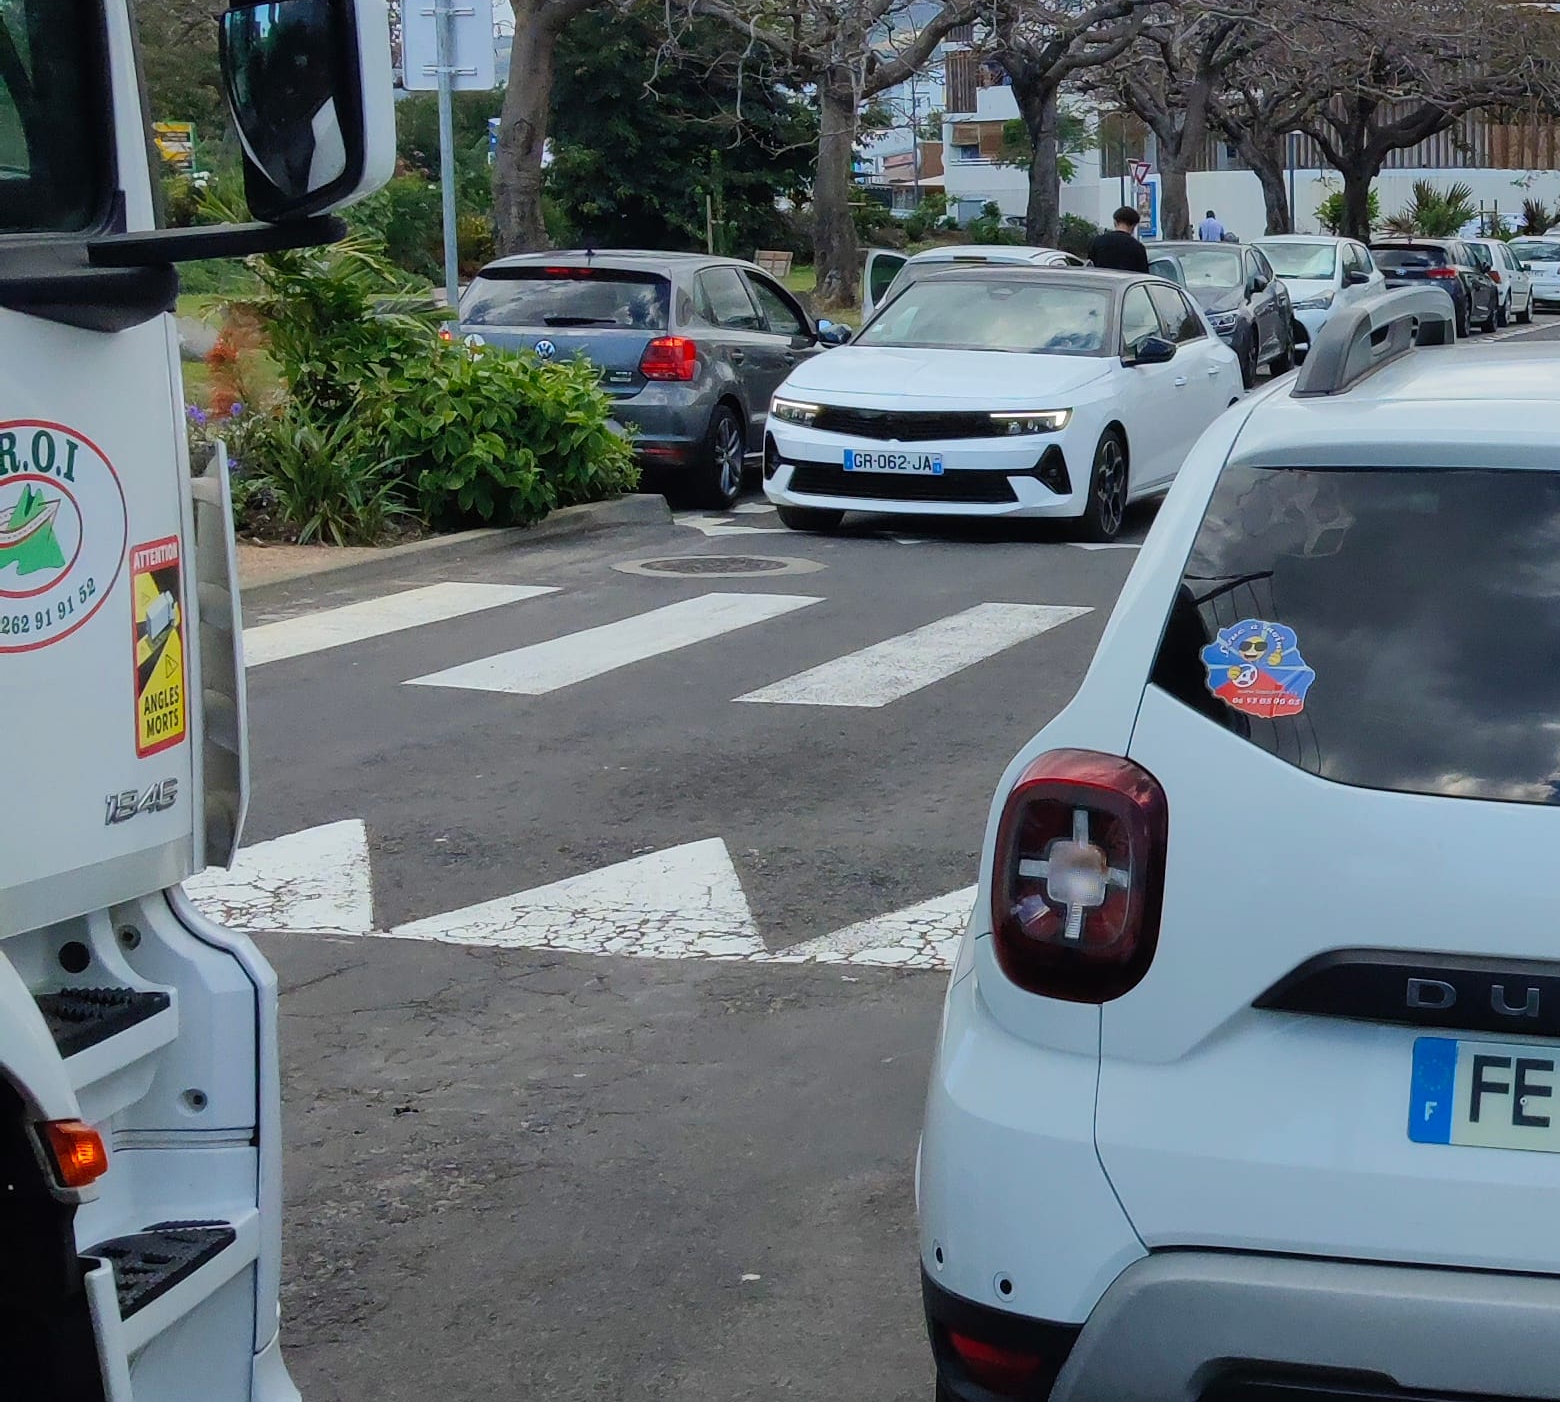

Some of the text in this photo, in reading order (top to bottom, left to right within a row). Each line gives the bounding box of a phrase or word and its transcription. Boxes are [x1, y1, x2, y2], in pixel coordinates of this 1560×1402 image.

[853, 453, 932, 472] GR-062-JA
[133, 540, 178, 570] ATTENTION
[35, 607, 53, 632] 91
[57, 595, 75, 622] 91
[78, 577, 97, 605] 52
[144, 684, 180, 716] ANGLES
[146, 707, 180, 739] MORTS
[1423, 1101, 1437, 1123] F
